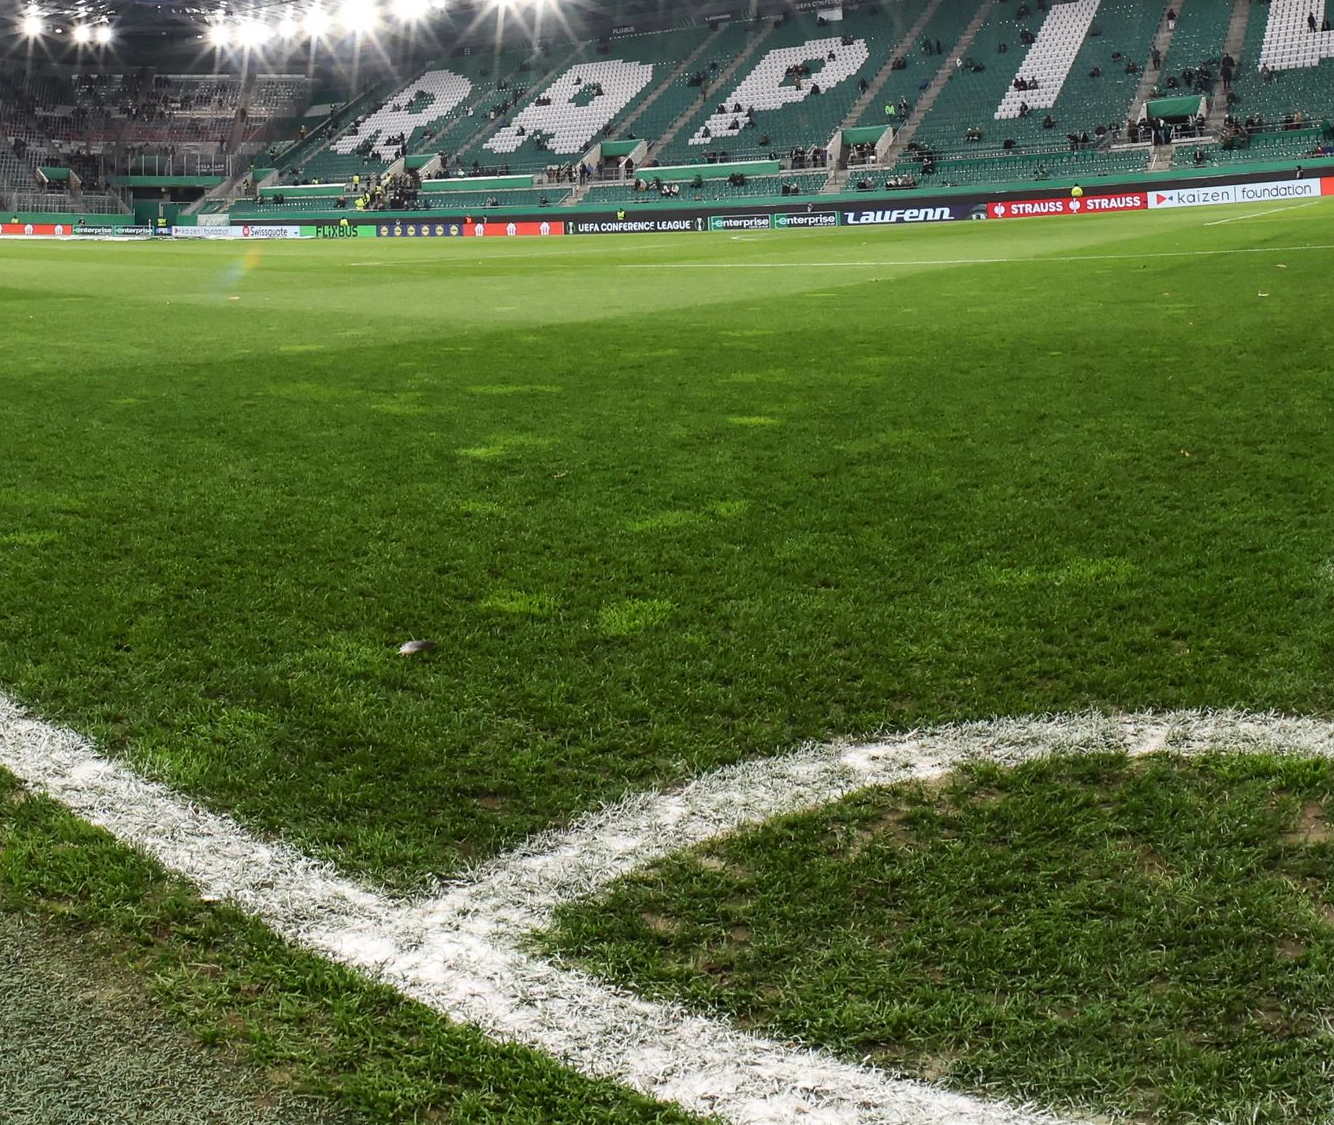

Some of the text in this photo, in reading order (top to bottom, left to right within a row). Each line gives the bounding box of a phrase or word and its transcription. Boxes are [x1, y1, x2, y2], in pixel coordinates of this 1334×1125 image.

[1177, 184, 1312, 204] kaizen foundation
[1010, 201, 1063, 214] STRAUSS
[1086, 196, 1141, 210] STRAUSS
[778, 215, 835, 227] enterprise
[844, 207, 955, 224] Laufenn
[578, 220, 691, 232] UEFA CONFERENCE LEAGUE
[714, 217, 769, 229] enterprise
[250, 226, 288, 237] Swissquote
